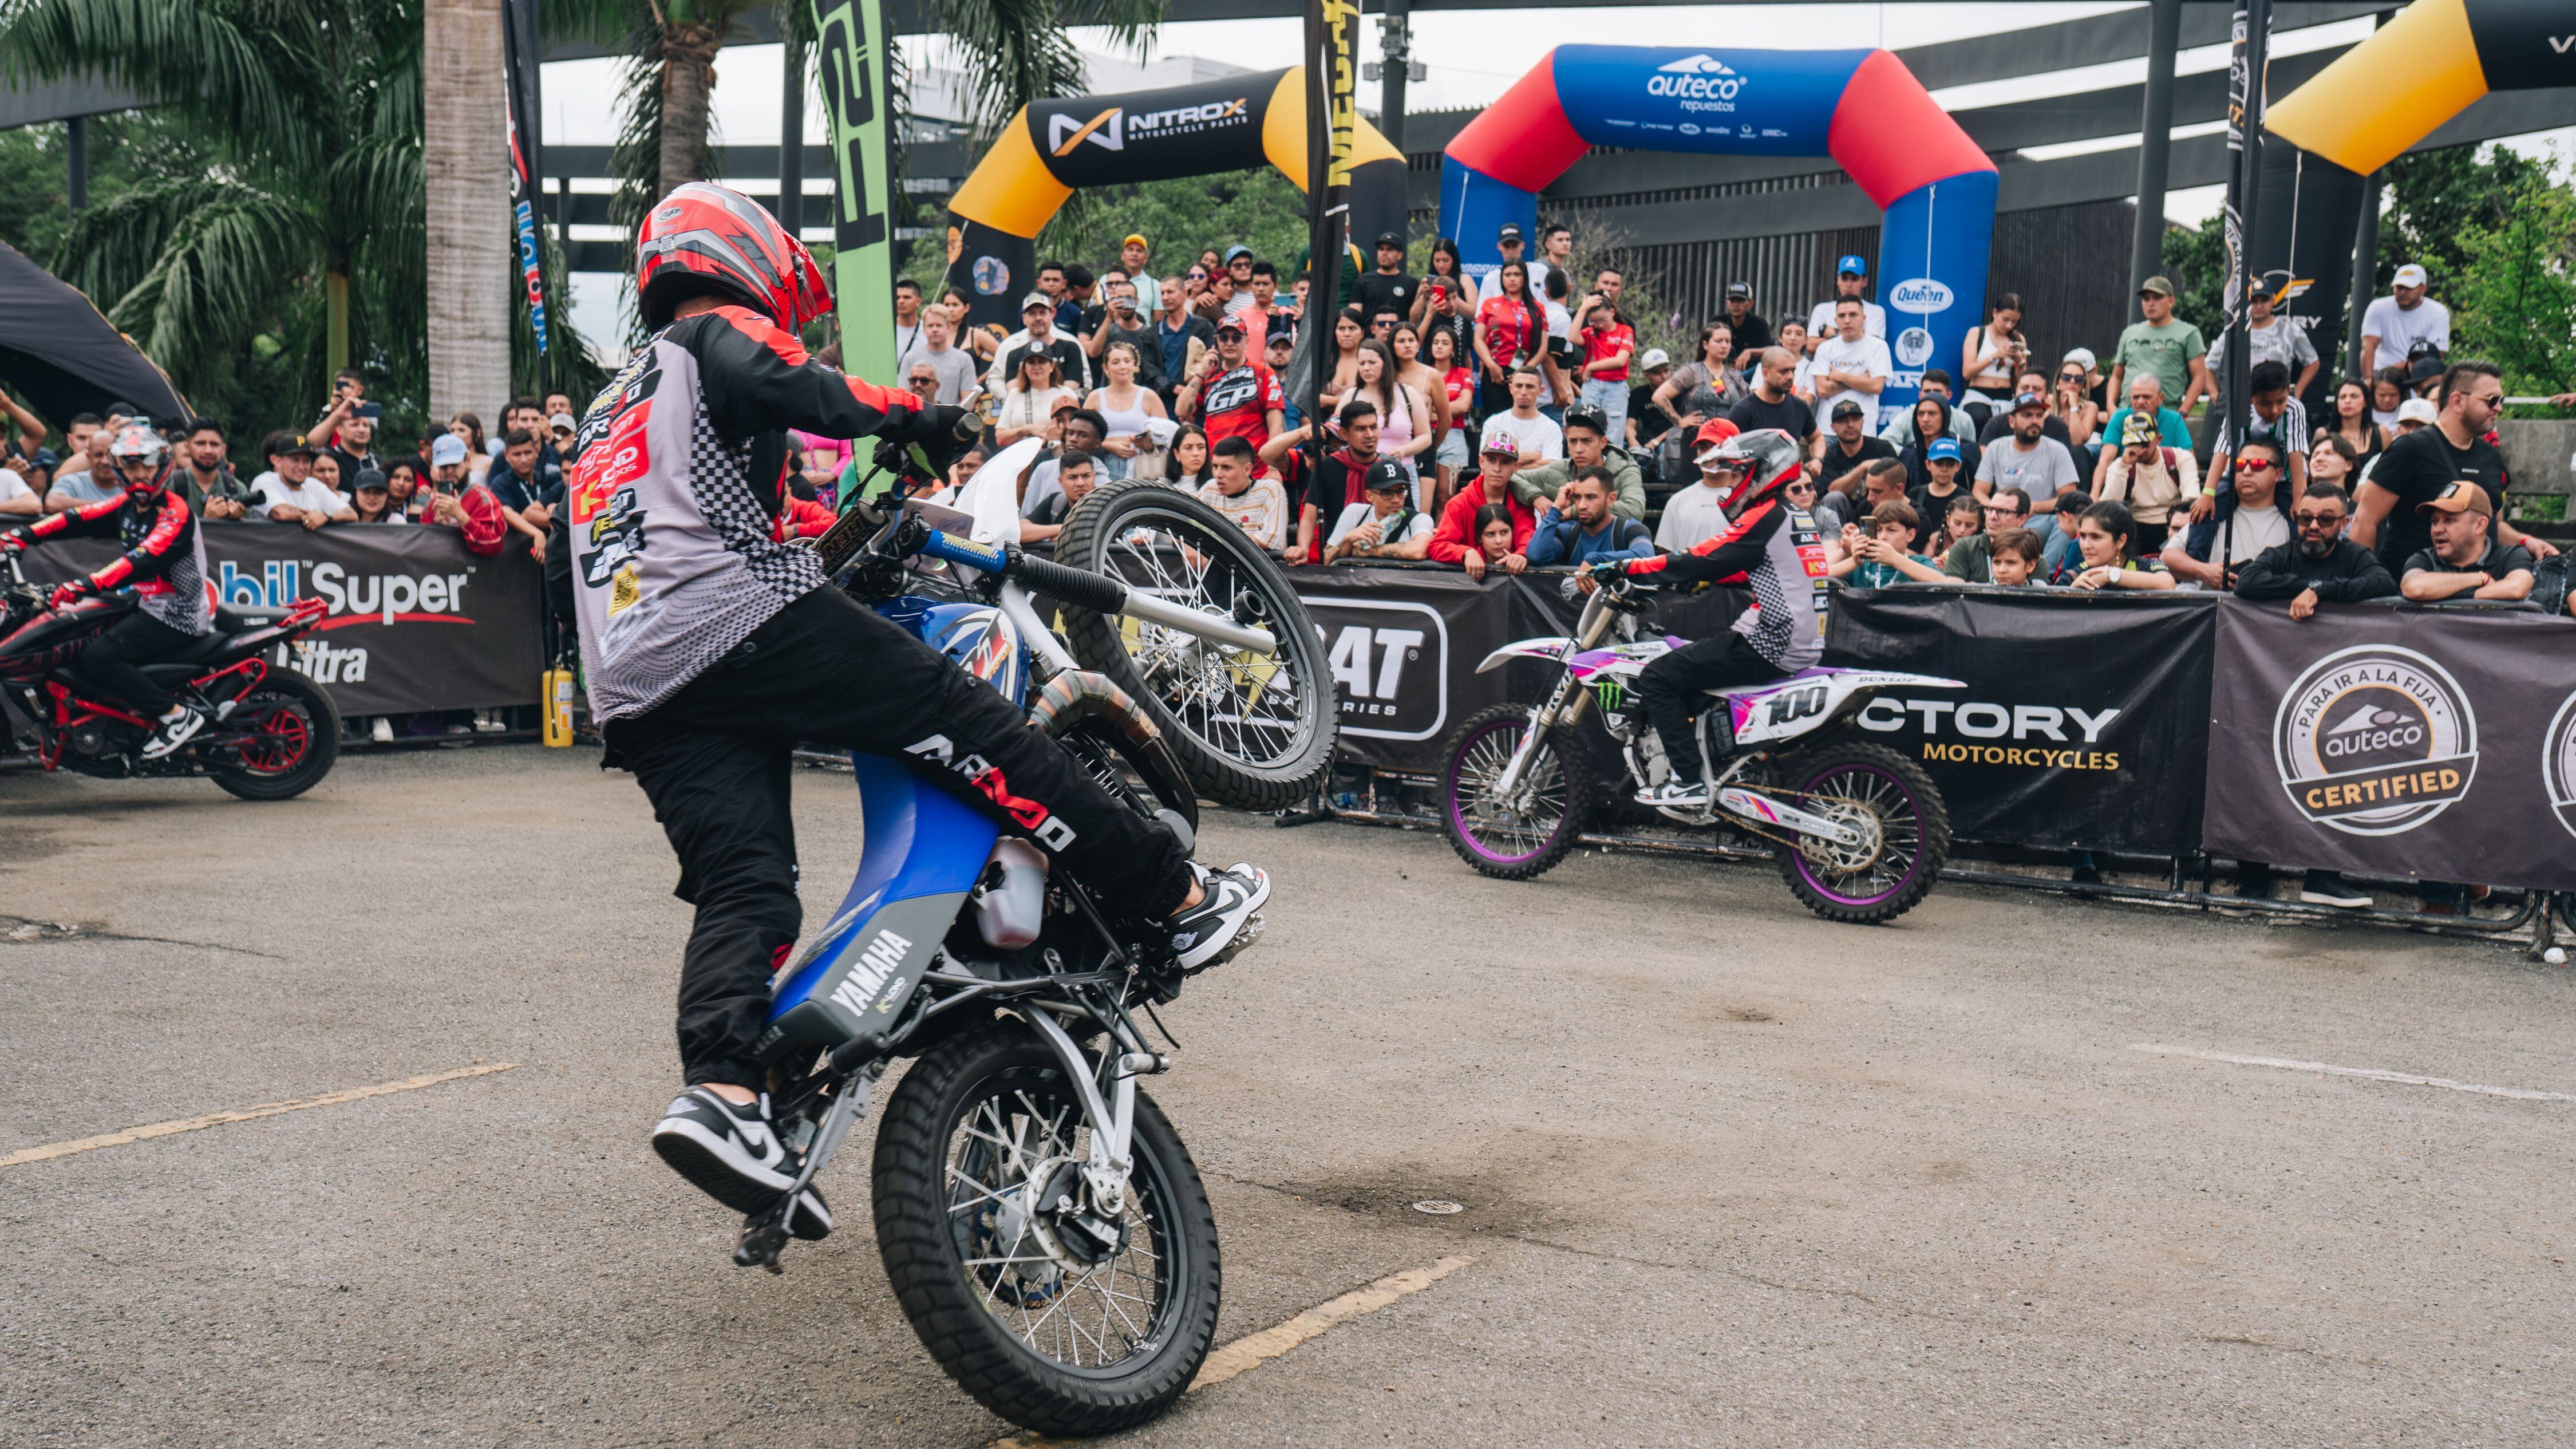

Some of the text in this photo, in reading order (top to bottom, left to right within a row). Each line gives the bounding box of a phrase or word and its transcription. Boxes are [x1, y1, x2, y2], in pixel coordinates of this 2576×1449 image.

[1647, 74, 1739, 100] auteco
[1129, 98, 1247, 131] NITROX
[1680, 100, 1736, 114] repuestos
[1129, 115, 1249, 141] MOTORCYCLE PARTS
[1897, 286, 1945, 302] Queen
[1206, 384, 1258, 413] GP
[296, 435, 305, 447] P
[1384, 464, 1397, 478] B
[311, 562, 468, 626] Super
[1858, 676, 1918, 684] DUNLOP
[1765, 686, 1830, 727] 100
[2300, 669, 2437, 728] PARA IR A LA FIJA
[2325, 725, 2422, 757] auteco
[1923, 743, 2119, 771] MOTORCYCLES
[2306, 768, 2460, 810] CERTIFIED
[829, 928, 913, 1017] YAMAHA
